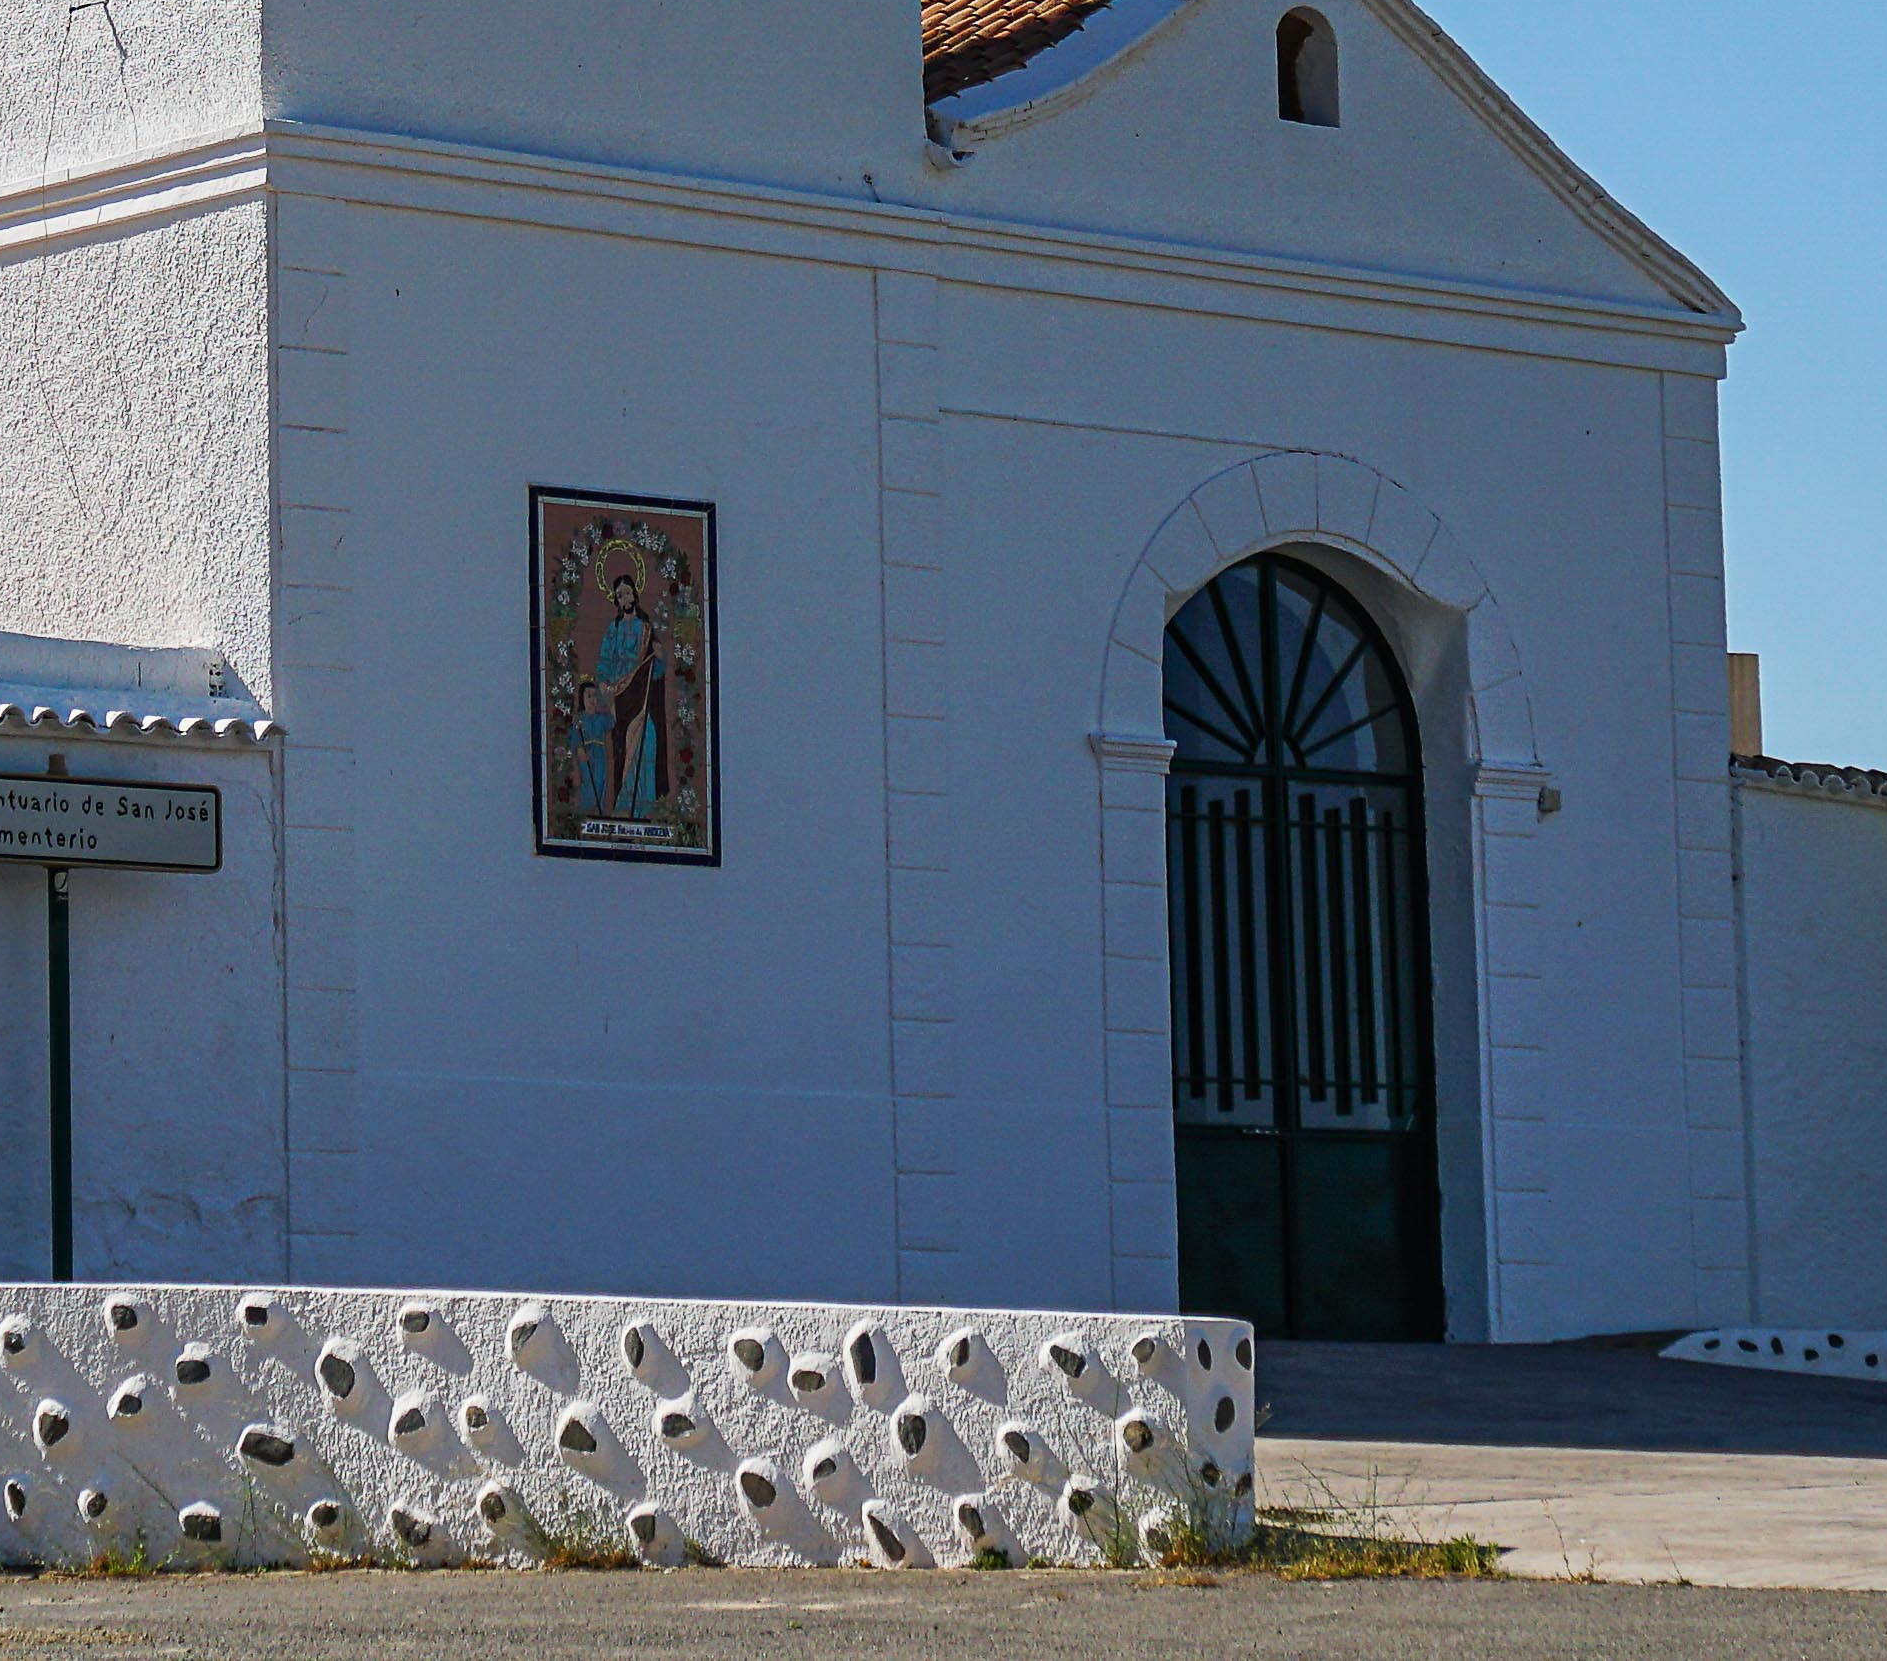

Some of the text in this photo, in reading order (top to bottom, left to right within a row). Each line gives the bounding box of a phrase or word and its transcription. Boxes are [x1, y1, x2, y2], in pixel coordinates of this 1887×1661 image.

[81, 795, 105, 816] de
[116, 796, 154, 819] San
[165, 800, 210, 822] José
